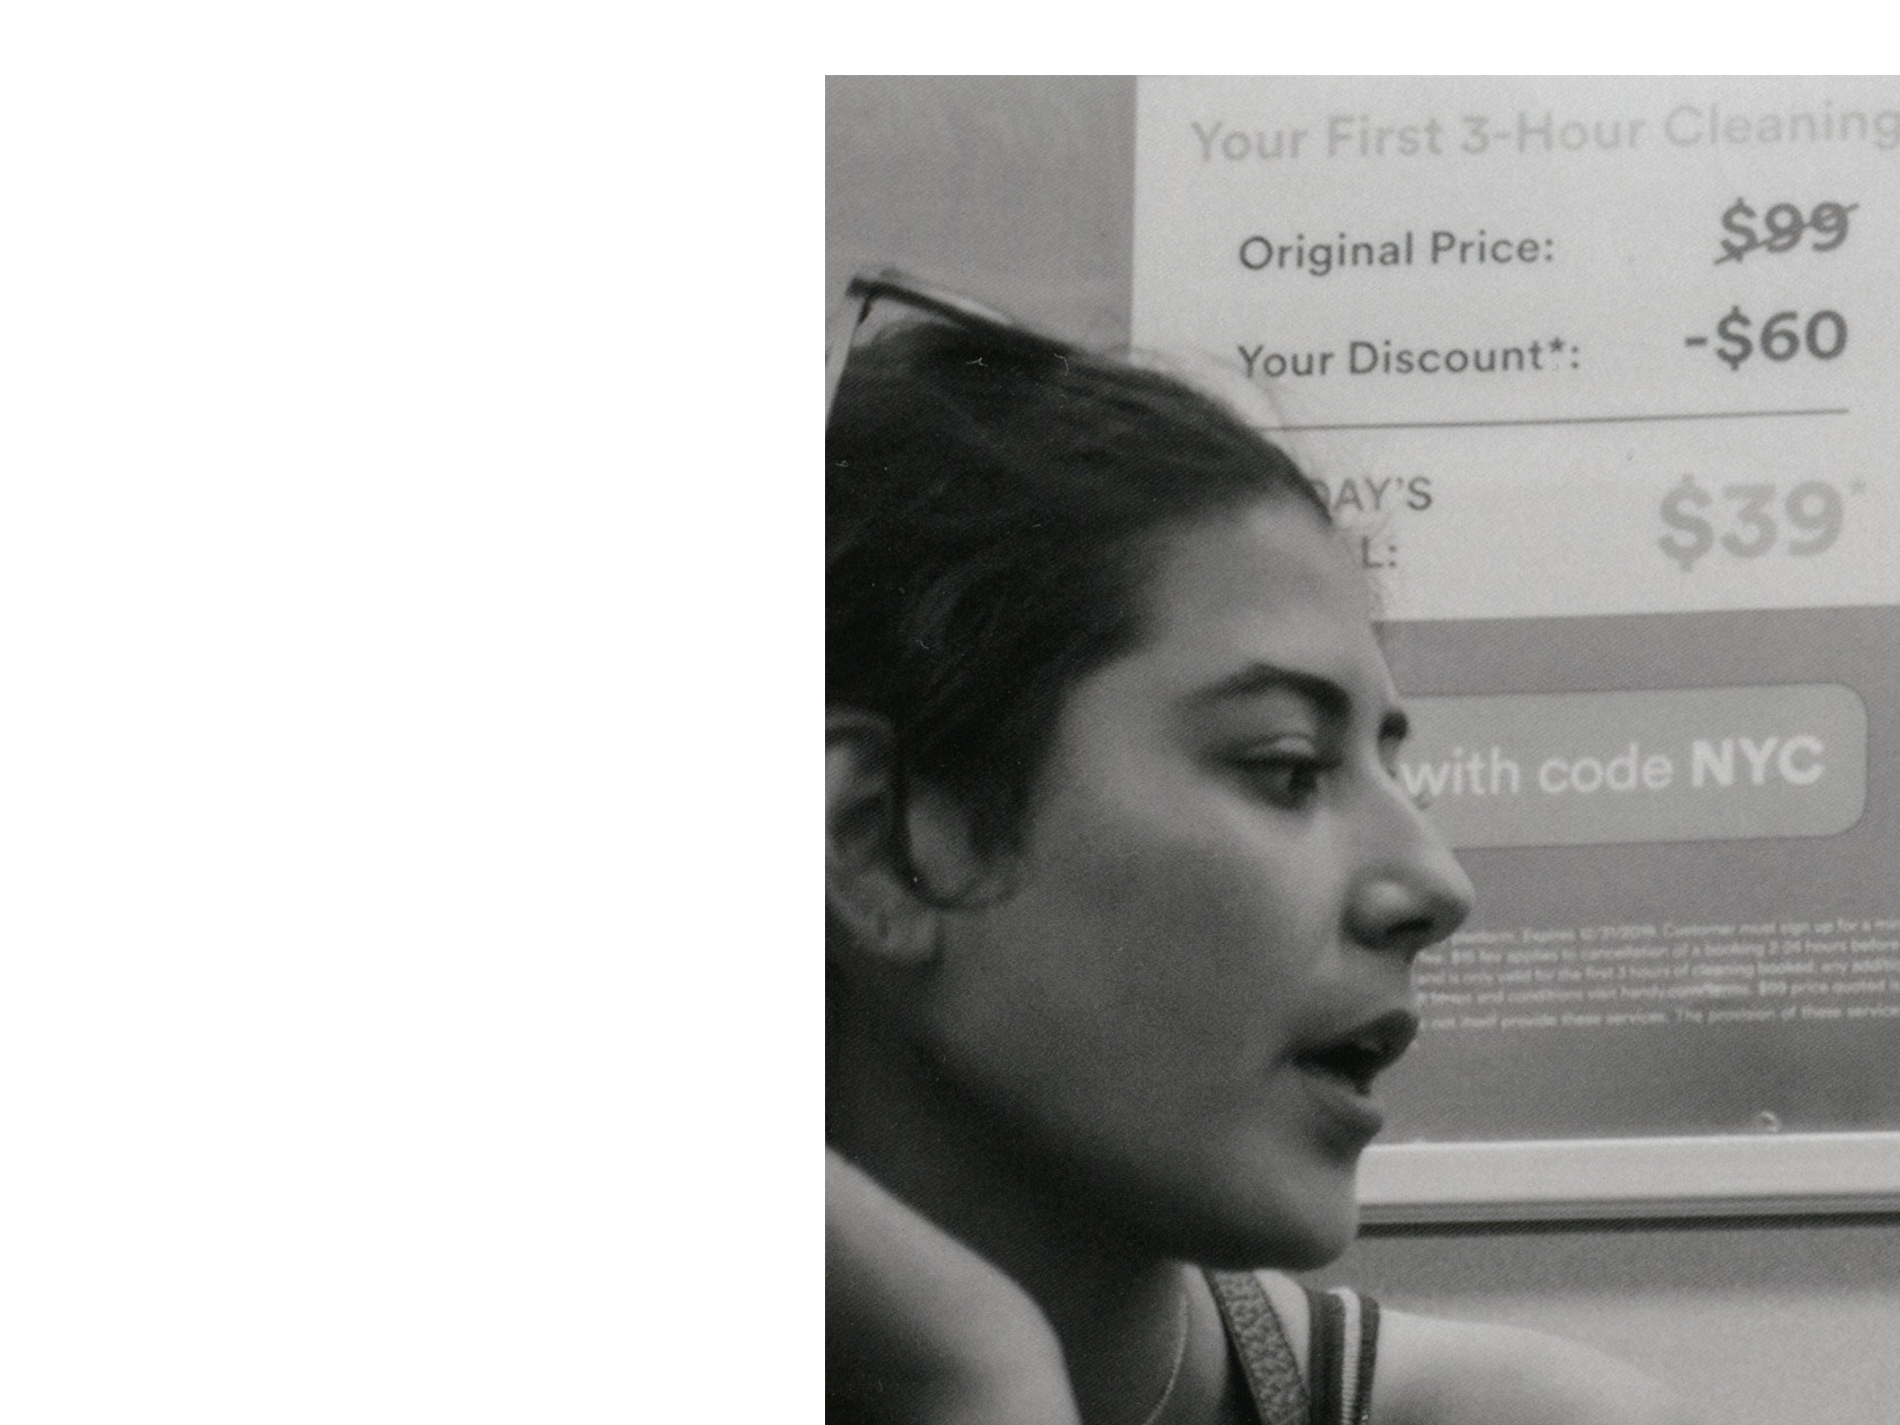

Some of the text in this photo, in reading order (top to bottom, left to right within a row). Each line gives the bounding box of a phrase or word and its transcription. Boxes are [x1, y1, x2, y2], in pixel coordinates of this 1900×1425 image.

[1190, 119, 1307, 163] Your
[1326, 115, 1443, 158] First
[1459, 110, 1645, 156] 3-Hour
[1238, 197, 1859, 277] Original Price: $99
[1236, 344, 1334, 380] Your
[1684, 305, 1849, 371] -$60
[1309, 476, 1433, 512] DAY'S
[1400, 735, 1825, 796] with code NYC
